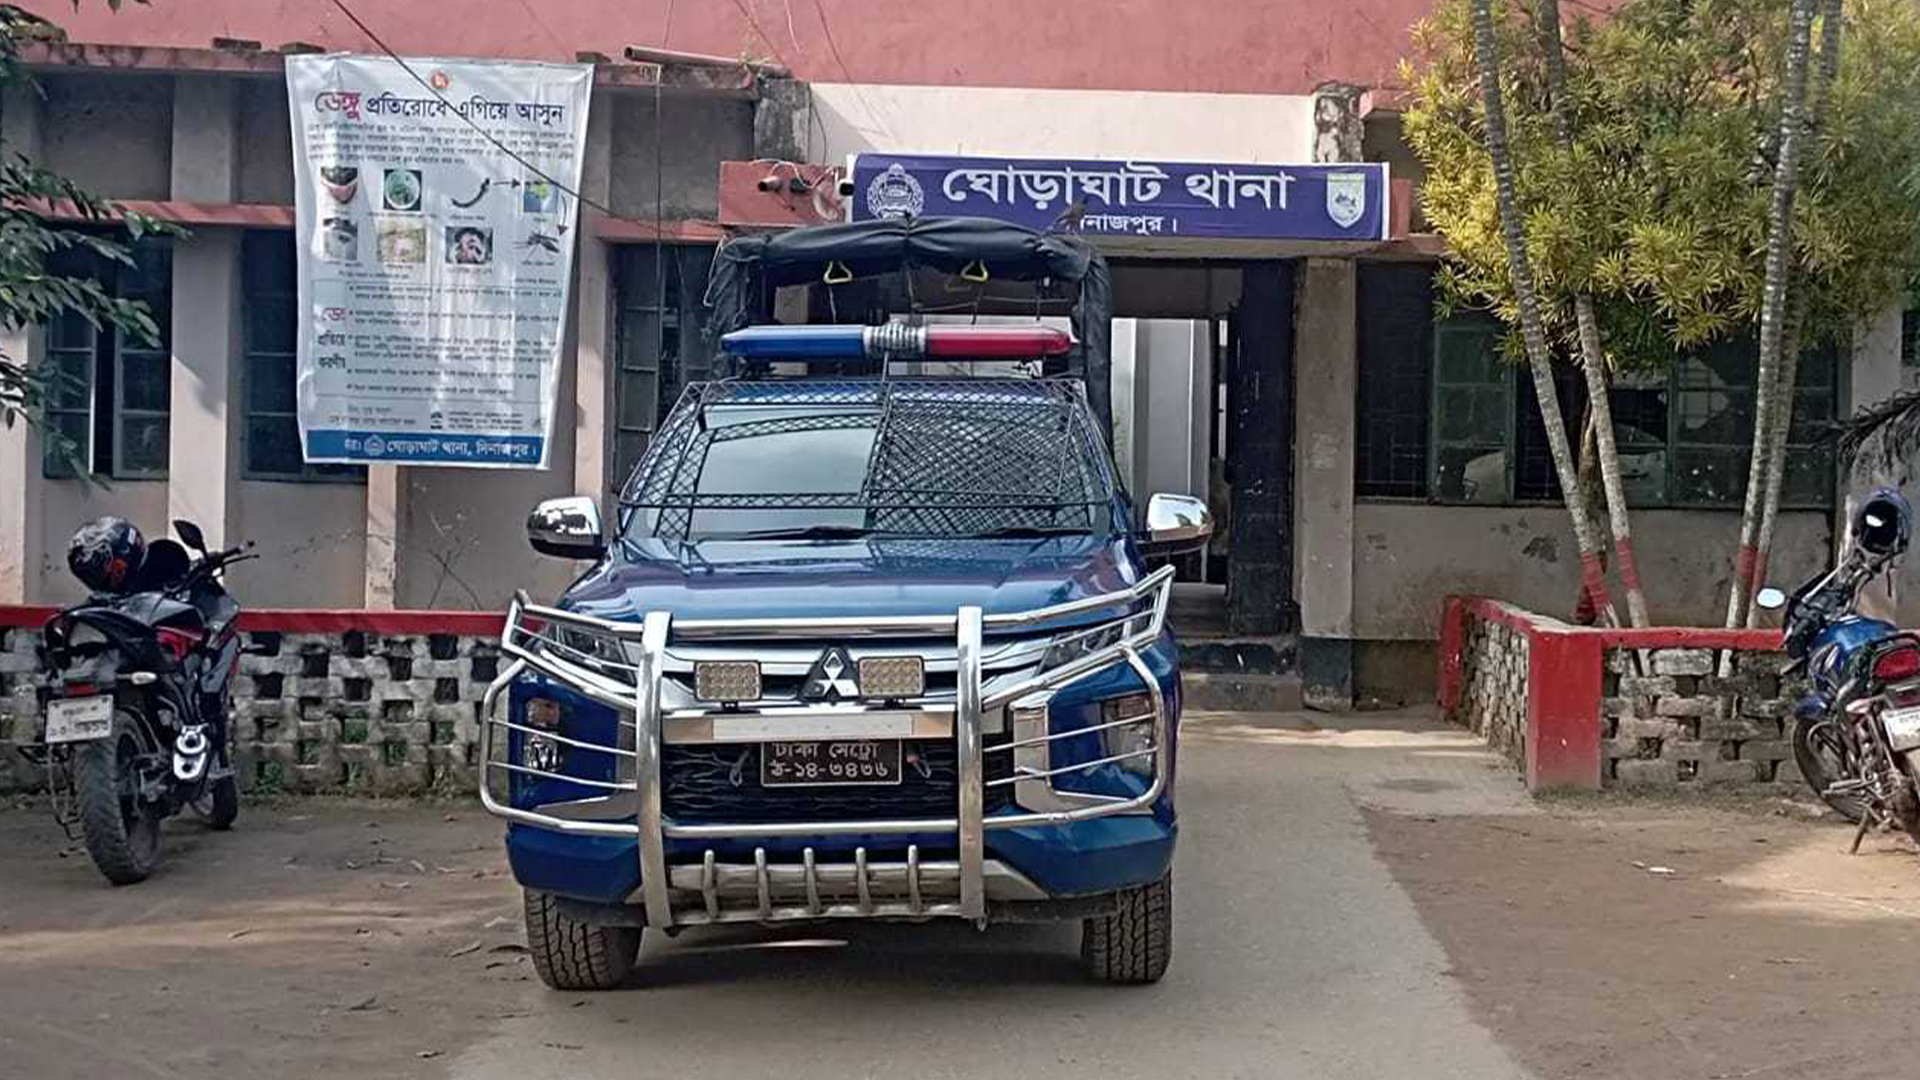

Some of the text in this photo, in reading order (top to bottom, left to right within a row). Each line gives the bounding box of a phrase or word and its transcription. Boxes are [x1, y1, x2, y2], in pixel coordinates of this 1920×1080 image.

[315, 91, 361, 121] ডেঙ্গু
[366, 91, 447, 117] প্রতিরোধে
[515, 102, 565, 127] আসুন
[943, 161, 1296, 209] ঘোড়াঘাট থানা
[772, 743, 882, 760] ঢাকা মেট্রো
